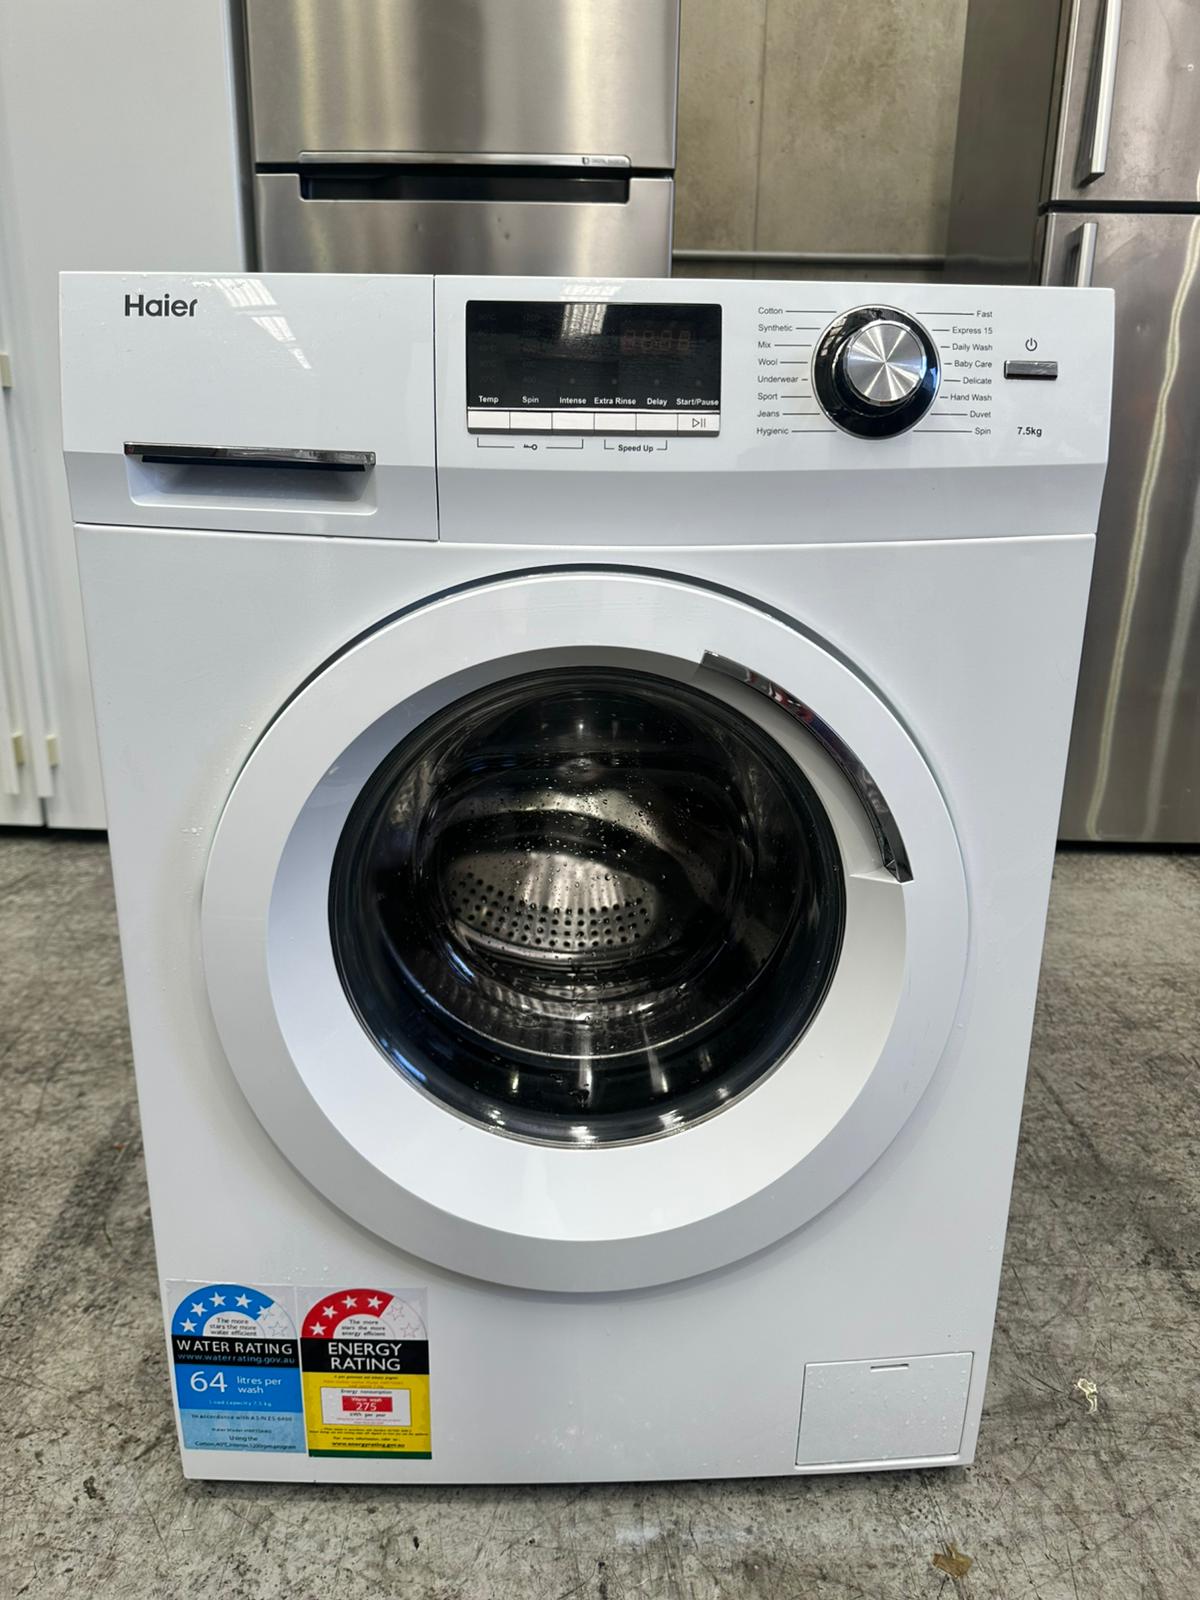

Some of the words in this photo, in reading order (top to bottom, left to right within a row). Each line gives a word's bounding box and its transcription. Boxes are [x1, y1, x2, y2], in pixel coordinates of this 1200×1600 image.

[124, 293, 198, 318] Haier
[757, 306, 784, 315] Cotton
[976, 310, 993, 318] Fast
[758, 323, 793, 333] Synthetic
[952, 326, 982, 336] Express
[983, 326, 993, 334] 15
[757, 341, 772, 349] Mix
[952, 343, 972, 352] Daily
[973, 343, 993, 351] Wash
[757, 358, 778, 366] Wool
[954, 360, 974, 369] Baby
[974, 360, 993, 368] Care
[757, 375, 799, 383] Underwear
[962, 376, 992, 385] Delicate
[478, 395, 500, 404] Temp
[522, 395, 540, 404] Spin
[559, 396, 587, 404] Intense
[594, 396, 612, 404] Extra
[613, 396, 637, 404] Rinse
[757, 392, 778, 401] Sport
[950, 393, 970, 401] Hand
[970, 393, 992, 401] Wash
[646, 397, 668, 407] Delay
[676, 397, 719, 406] Start/Pause
[757, 409, 780, 417] Jeans
[969, 410, 991, 418] Duvet
[756, 427, 789, 436] Hygienic
[974, 427, 991, 436] Spin
[1017, 427, 1042, 437] 7.5kg
[618, 444, 642, 452] Speed
[642, 444, 654, 452] Up
[176, 1339, 230, 1353] WATER
[234, 1341, 293, 1355] RATING
[328, 1341, 402, 1356] ENERGY
[177, 1352, 296, 1365] www.waterrating.gov.au
[330, 1356, 401, 1371] RATING
[190, 1370, 228, 1393] 64
[236, 1376, 262, 1386] litres
[264, 1378, 282, 1387] per
[237, 1385, 264, 1394] wash
[355, 1402, 377, 1412] 275
